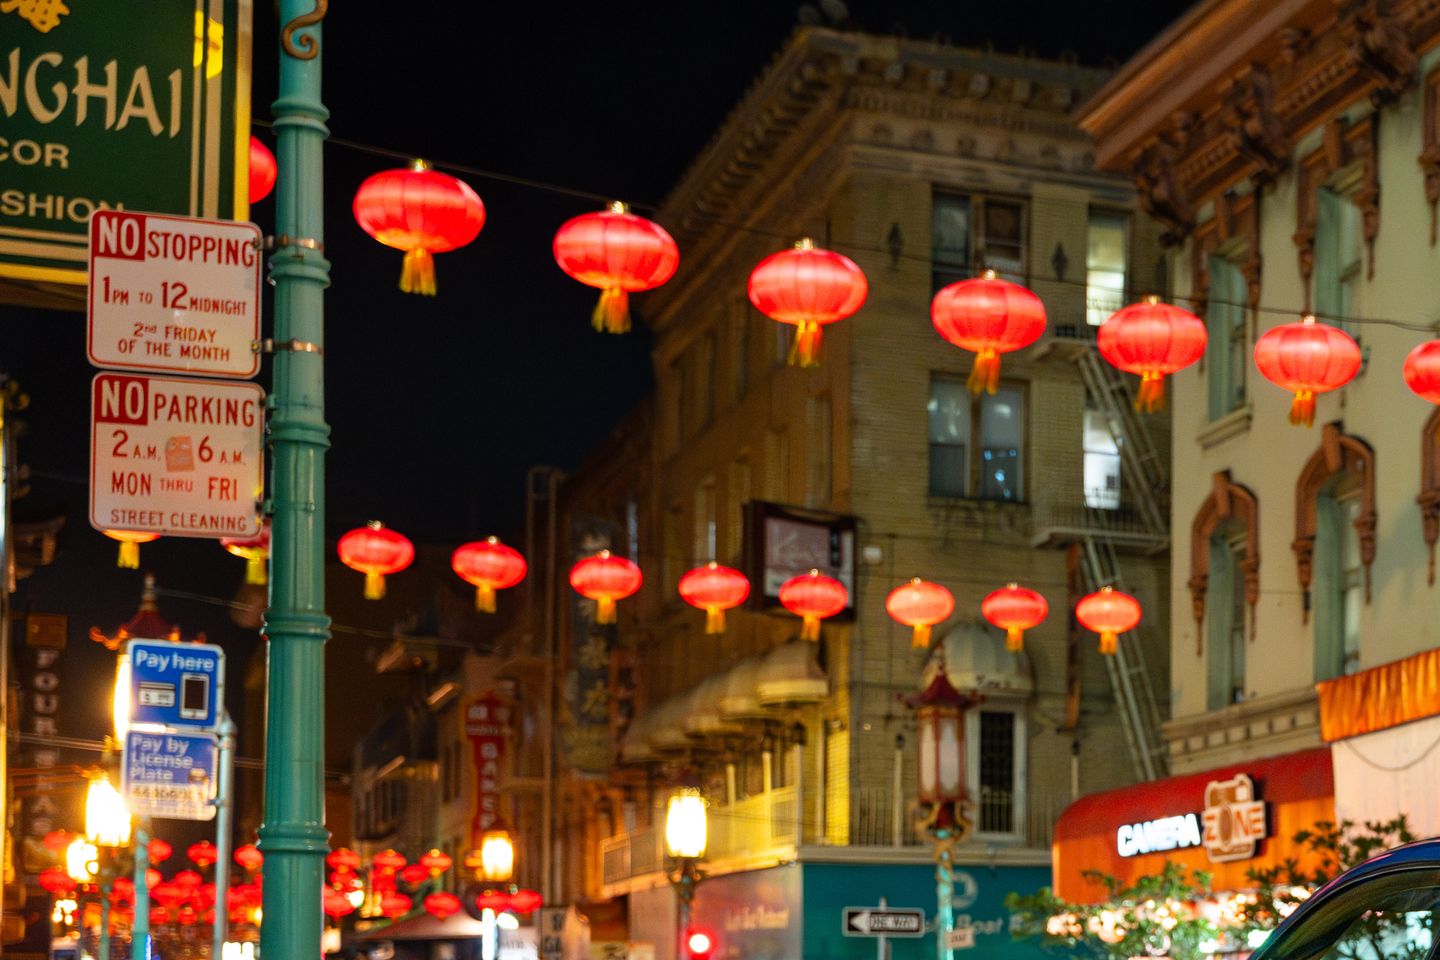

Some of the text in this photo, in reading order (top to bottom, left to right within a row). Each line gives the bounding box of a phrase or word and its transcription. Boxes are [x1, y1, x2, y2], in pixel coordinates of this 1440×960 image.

[0, 189, 125, 222] SHIO
[98, 215, 255, 267] NO STOPPING
[139, 292, 153, 304] TO
[165, 325, 216, 343] FRIDAY
[118, 339, 230, 361] OF THE MONTH
[101, 379, 255, 428] NO PARKING
[112, 430, 128, 458] 2
[198, 435, 213, 463] 6
[111, 472, 237, 501] MON THRU FRI
[111, 509, 247, 531] STREET CLEANING
[136, 649, 214, 672] Pay here
[131, 734, 189, 757] Pay by
[131, 752, 193, 769] License
[130, 766, 173, 781] Plate
[1117, 813, 1201, 857] CAMERA
